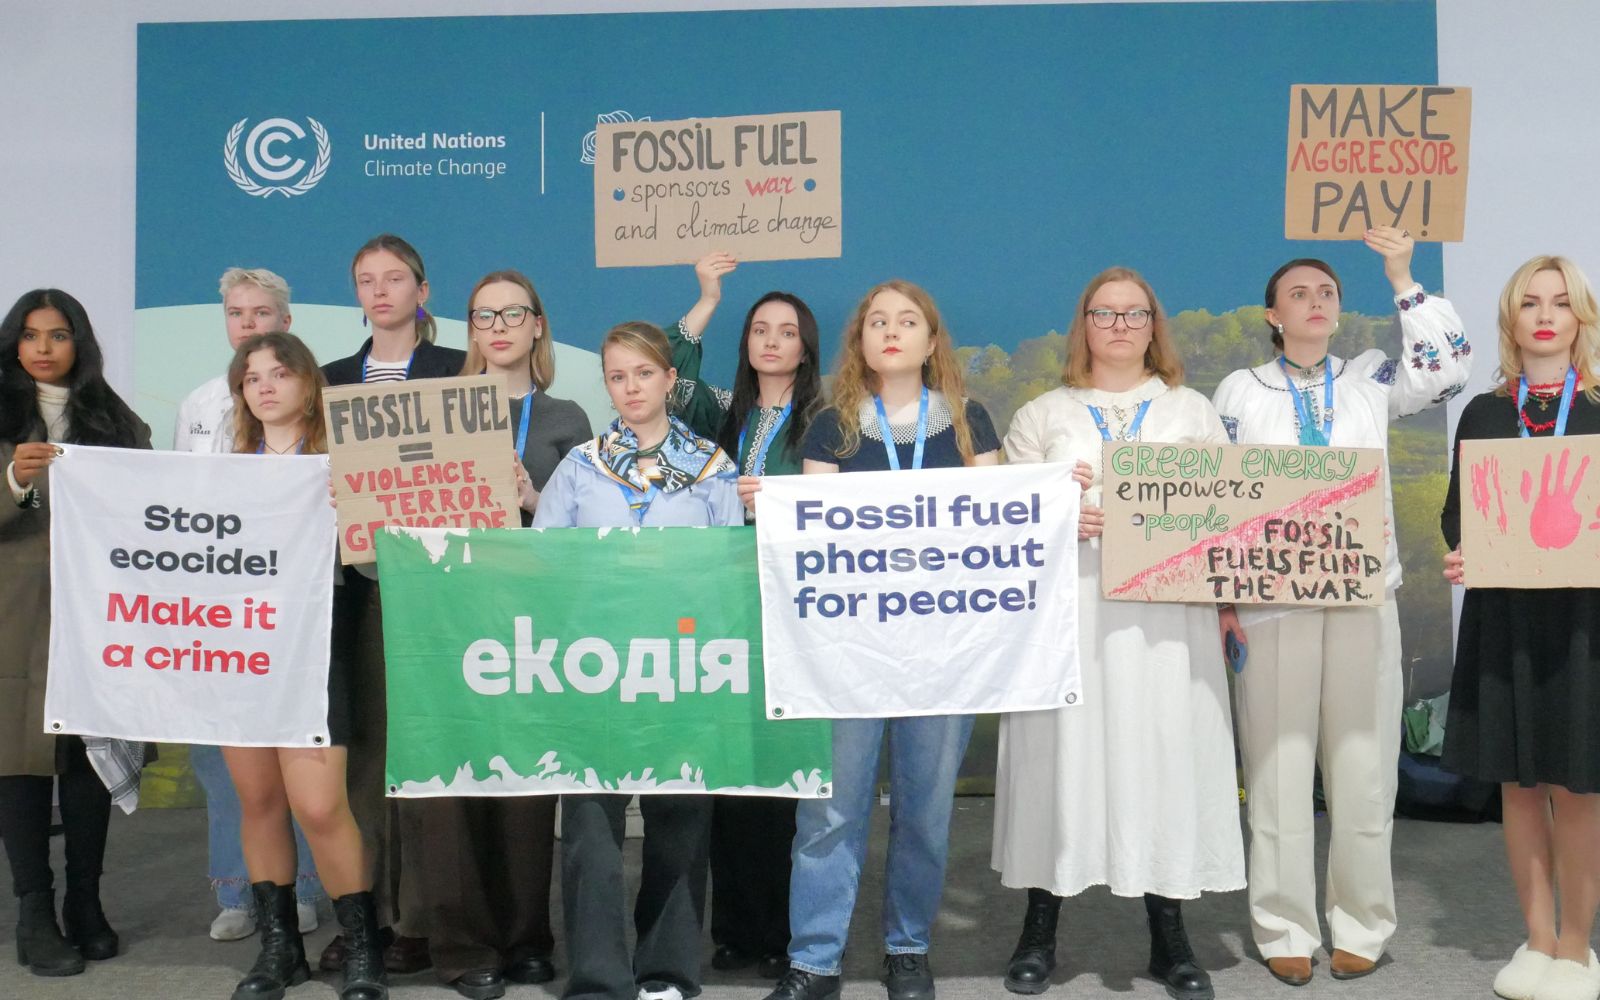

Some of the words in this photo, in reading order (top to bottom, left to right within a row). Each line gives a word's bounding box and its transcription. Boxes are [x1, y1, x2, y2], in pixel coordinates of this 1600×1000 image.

[1301, 87, 1455, 140] MAKE
[364, 134, 426, 150] United
[433, 132, 506, 149] Nations
[735, 121, 817, 167] FUEL
[364, 160, 432, 177] Climate
[437, 158, 506, 178] Change
[631, 179, 731, 212] sponsors
[746, 176, 796, 197] war
[1312, 179, 1432, 236] PAY!
[614, 204, 658, 241] and
[677, 201, 759, 238] climate
[767, 196, 837, 243] change
[329, 391, 430, 445] FOSSIL
[441, 385, 508, 434] FUEL
[796, 494, 937, 531] Fossil
[948, 493, 1041, 526] fuel
[1116, 480, 1264, 514] empowers
[144, 505, 241, 539] Stop
[1145, 504, 1230, 541] people
[109, 545, 278, 576] ecocide!
[795, 538, 1044, 581] phase-out
[1299, 550, 1382, 577] FUND
[793, 586, 867, 618] for
[878, 580, 1037, 622] peace!
[1206, 575, 1276, 600] THE
[107, 592, 232, 628] Make
[243, 597, 276, 630] it
[102, 644, 134, 667] a
[144, 640, 270, 675] crime
[462, 615, 749, 703] екодія
